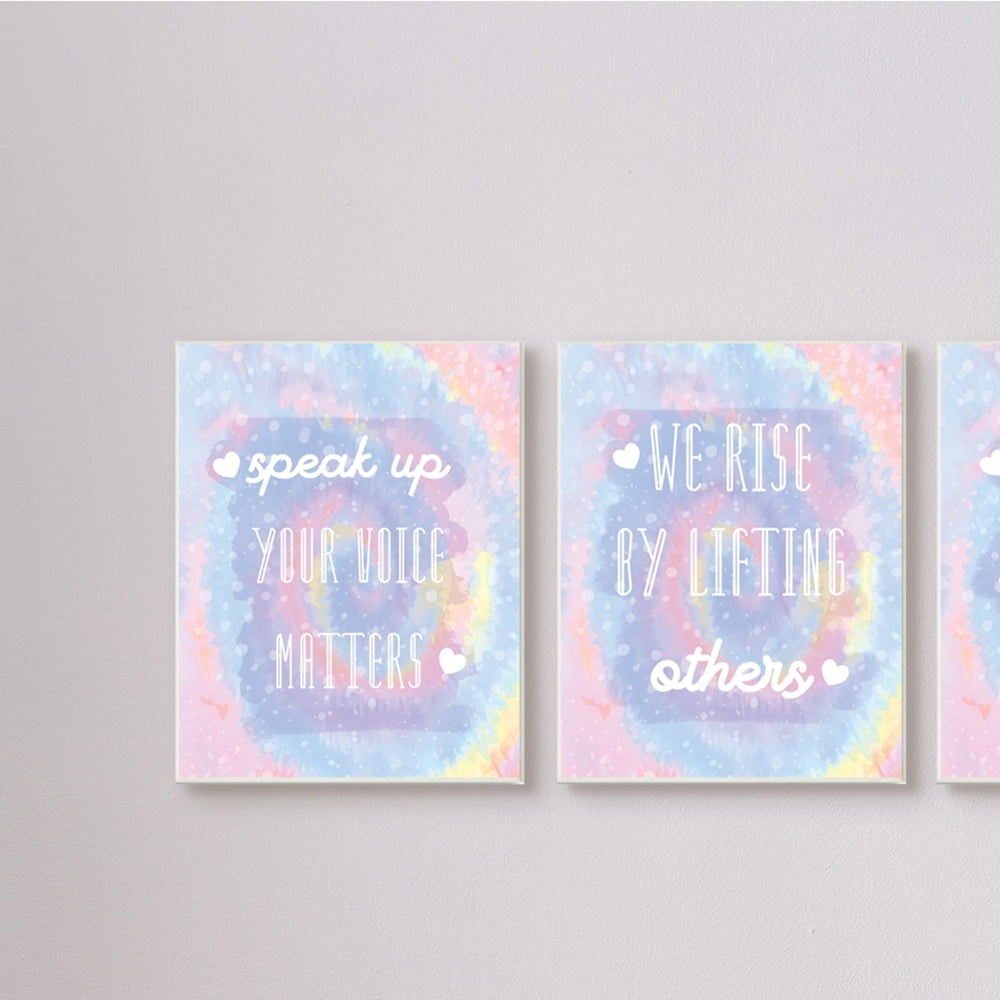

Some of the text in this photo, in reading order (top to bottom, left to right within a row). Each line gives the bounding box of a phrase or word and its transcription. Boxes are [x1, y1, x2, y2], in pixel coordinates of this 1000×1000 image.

[245, 436, 451, 497] speak up
[650, 423, 812, 492] WE RISE
[252, 528, 445, 584] YOUR VOICE
[616, 528, 845, 597] BY LIFTING
[275, 633, 423, 689] MATTERS
[650, 639, 815, 699] others
